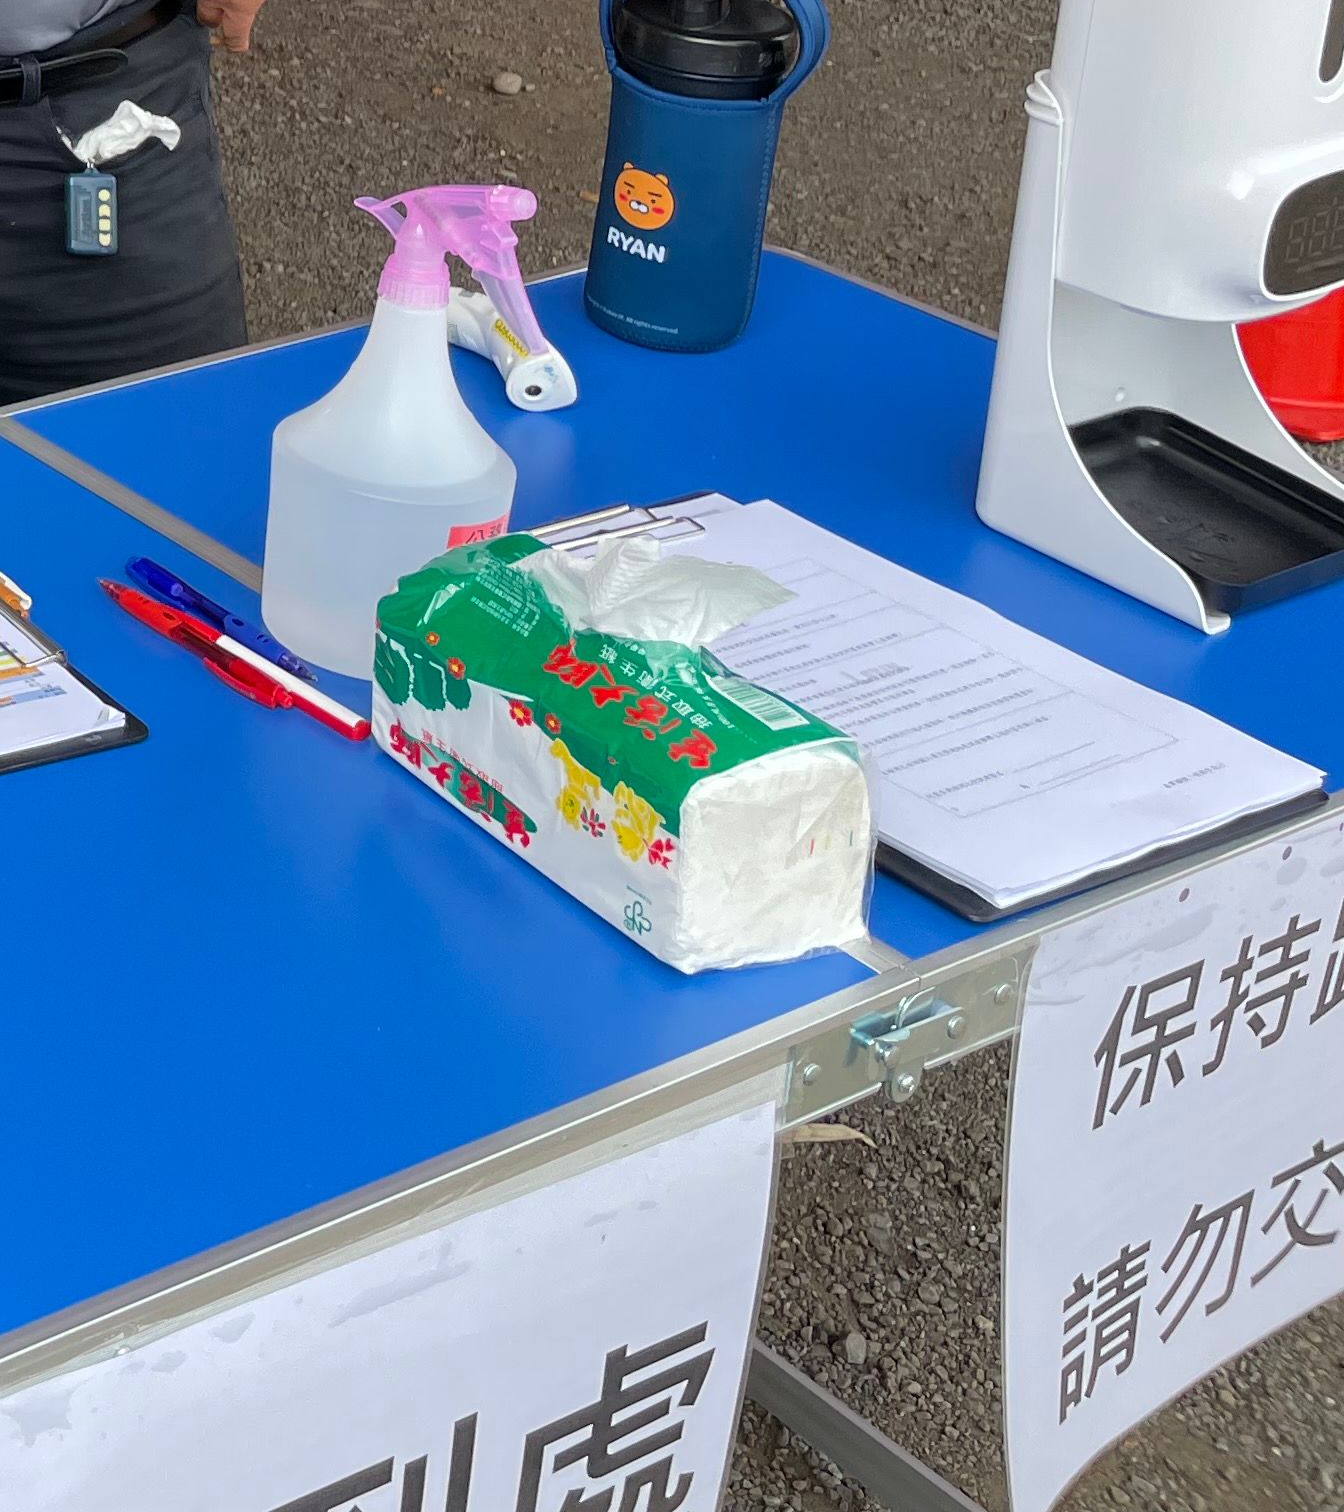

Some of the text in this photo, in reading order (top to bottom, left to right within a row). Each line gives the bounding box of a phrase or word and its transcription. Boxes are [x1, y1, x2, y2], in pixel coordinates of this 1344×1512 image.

[606, 225, 667, 264] RYAN
[541, 638, 718, 770] 生活大師
